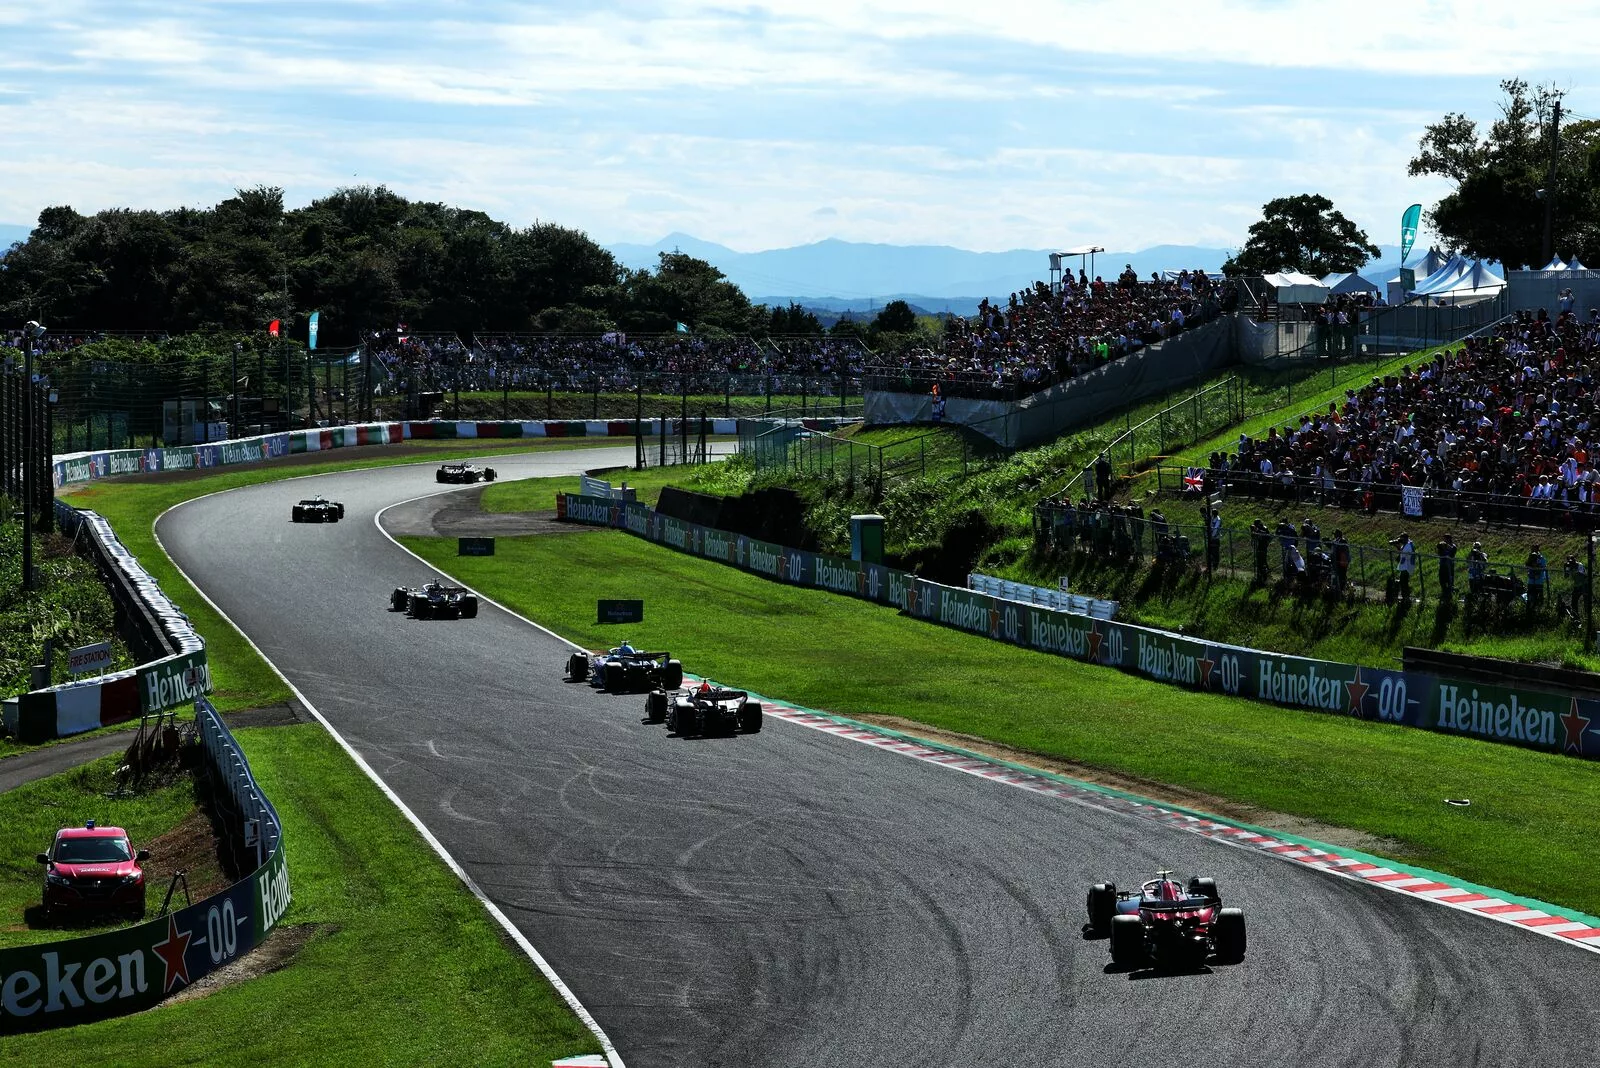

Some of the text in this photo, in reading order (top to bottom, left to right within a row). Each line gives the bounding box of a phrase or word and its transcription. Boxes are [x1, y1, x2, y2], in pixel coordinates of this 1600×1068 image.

[109, 453, 139, 474] Heineken
[163, 450, 193, 468] Heineken
[222, 442, 261, 464] Heineken
[65, 461, 90, 482] Heineken
[566, 496, 608, 521] Heineken
[749, 543, 777, 575] Heineken
[815, 557, 857, 592] Heineken
[940, 590, 987, 632] Heineken
[71, 650, 110, 668] FIRE STATION
[1137, 634, 1195, 684] Heineken
[1258, 659, 1341, 710] Heineken
[1437, 684, 1556, 745] Heineken
[0, 952, 148, 1017] eken
